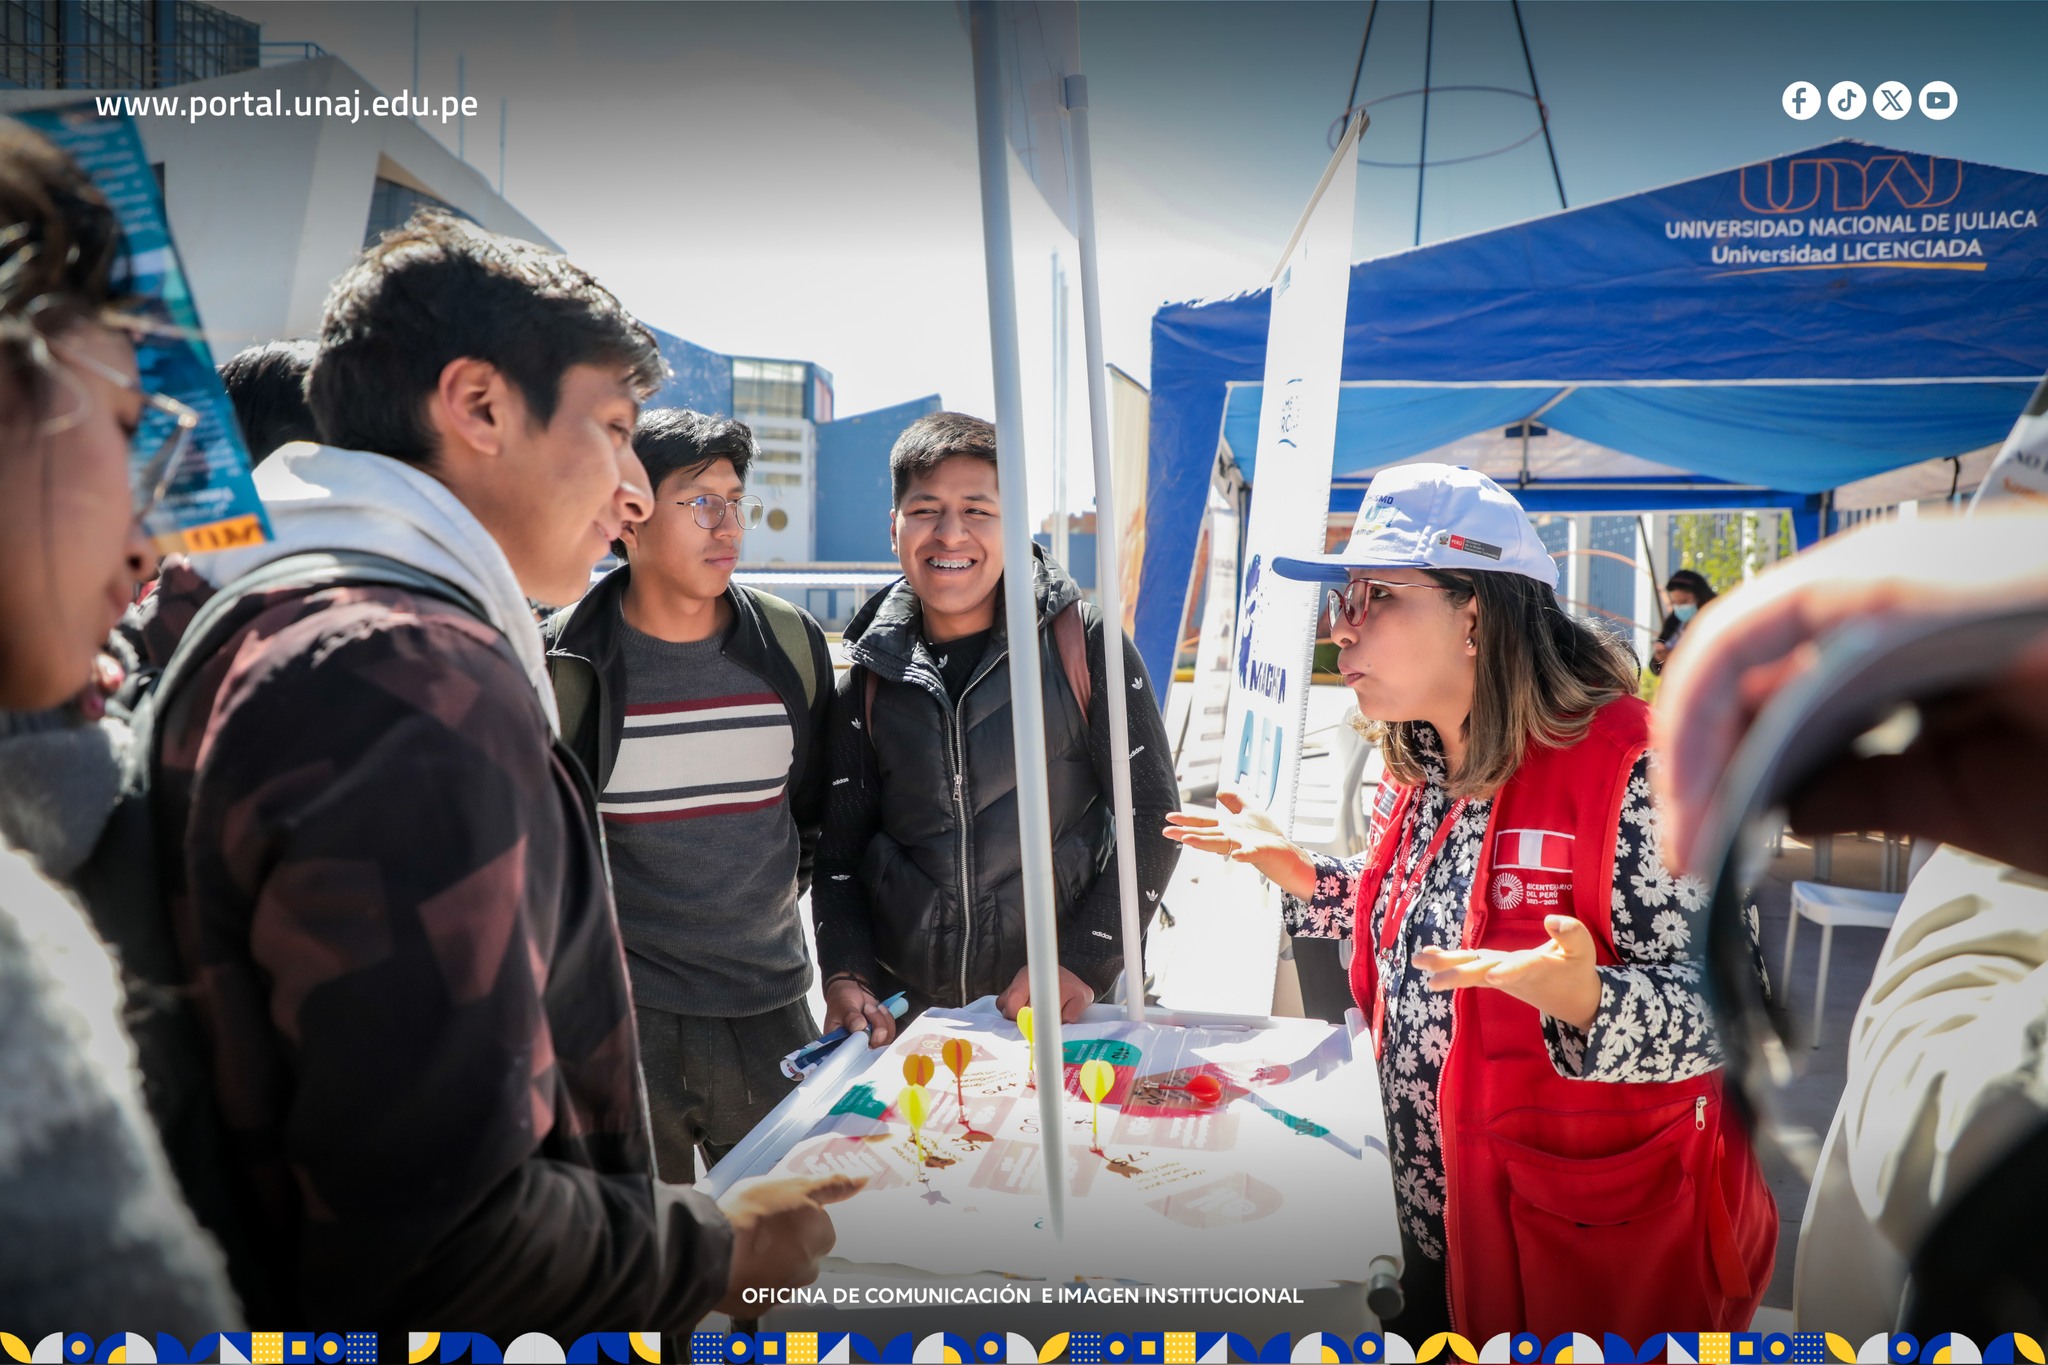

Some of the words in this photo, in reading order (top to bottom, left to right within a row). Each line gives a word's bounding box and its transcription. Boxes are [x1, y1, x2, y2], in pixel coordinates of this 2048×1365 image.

[1665, 217, 1804, 239] UNIVERSIDAD
[1809, 213, 1916, 237] NACIONAL
[1921, 212, 1950, 232] DE
[1954, 209, 2038, 234] JULIACA
[1711, 242, 1837, 264] Universidad
[1843, 238, 1983, 262] LICENCIADA
[1450, 798, 1467, 821] MIMP
[1403, 880, 1418, 902] MIMP
[1417, 852, 1435, 876] AURORA
[1526, 890, 1537, 898] DEL
[1539, 889, 1558, 899] PERÚ
[1091, 930, 1113, 940] adidas
